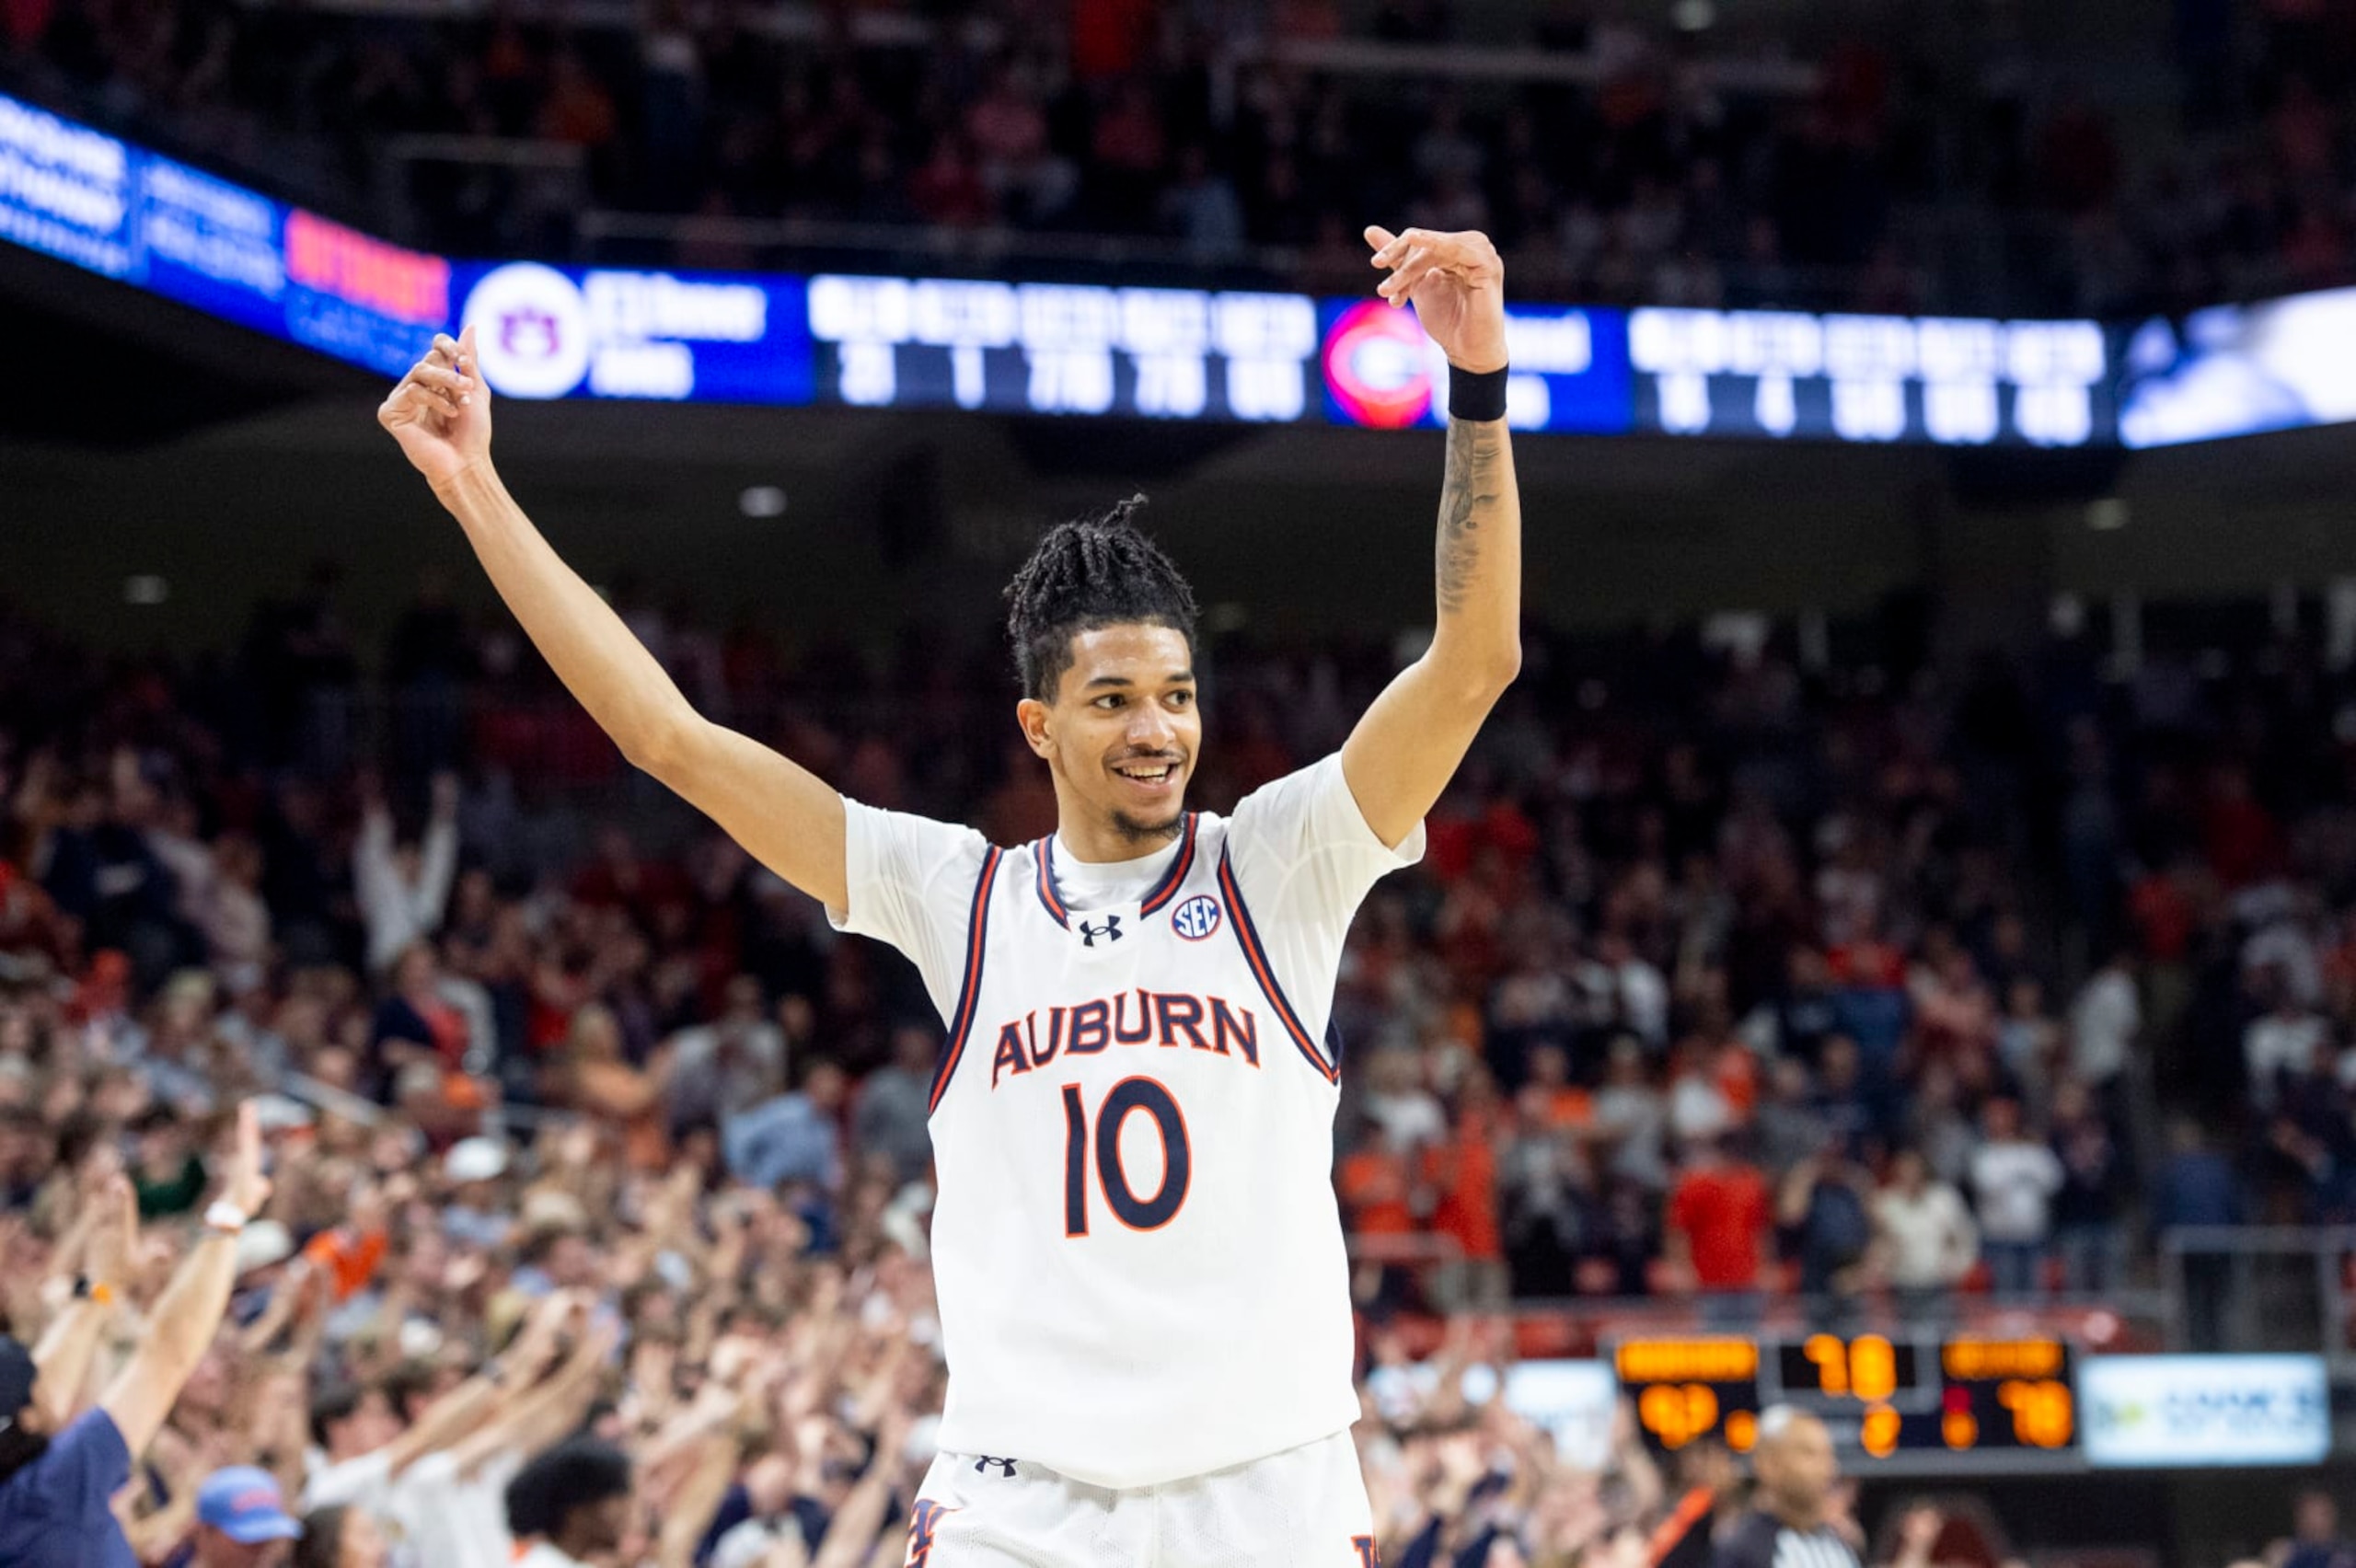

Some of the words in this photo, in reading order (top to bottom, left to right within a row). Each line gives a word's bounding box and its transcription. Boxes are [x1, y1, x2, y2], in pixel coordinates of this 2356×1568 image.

[1176, 898, 1218, 937] SEC
[992, 988, 1260, 1090] AUBURN
[1062, 1076, 1190, 1238] 10
